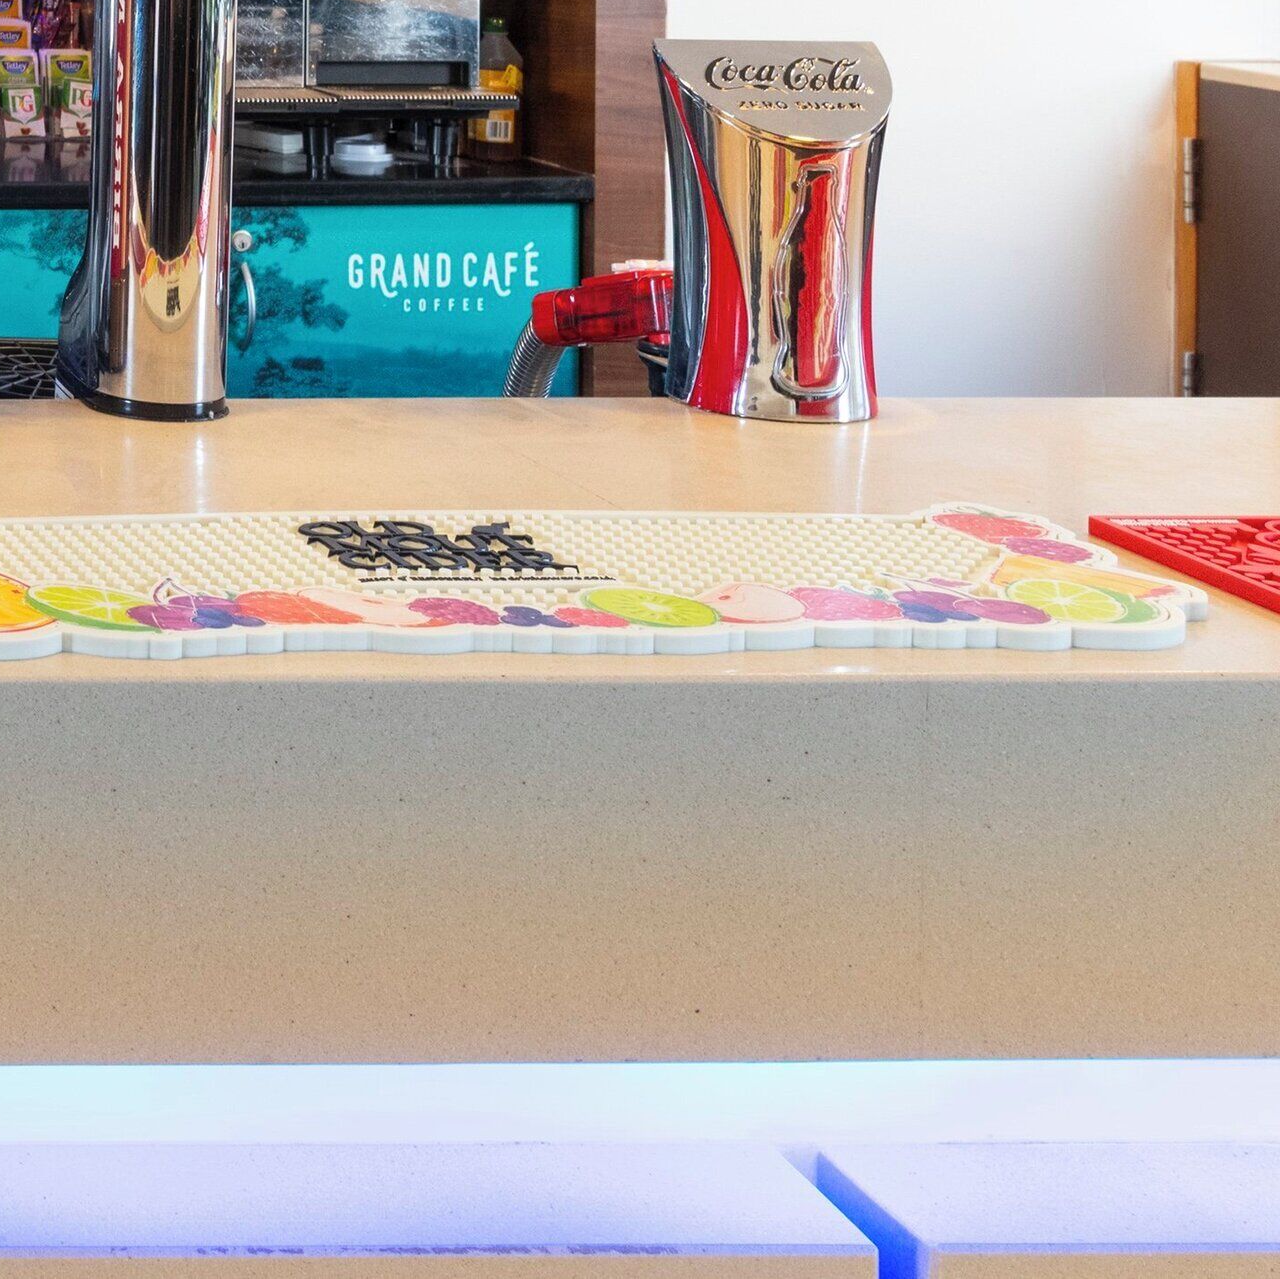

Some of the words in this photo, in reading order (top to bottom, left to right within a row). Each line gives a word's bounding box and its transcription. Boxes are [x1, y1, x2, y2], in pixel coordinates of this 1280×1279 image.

[5, 62, 27, 70] Tetley
[59, 62, 82, 70] Tetley
[11, 95, 34, 112] PG
[738, 100, 789, 111] ZERO
[793, 100, 866, 111] SUGAR
[348, 252, 452, 298] GRAND
[463, 242, 539, 297] CAFÉ
[403, 297, 485, 312] COFFEE
